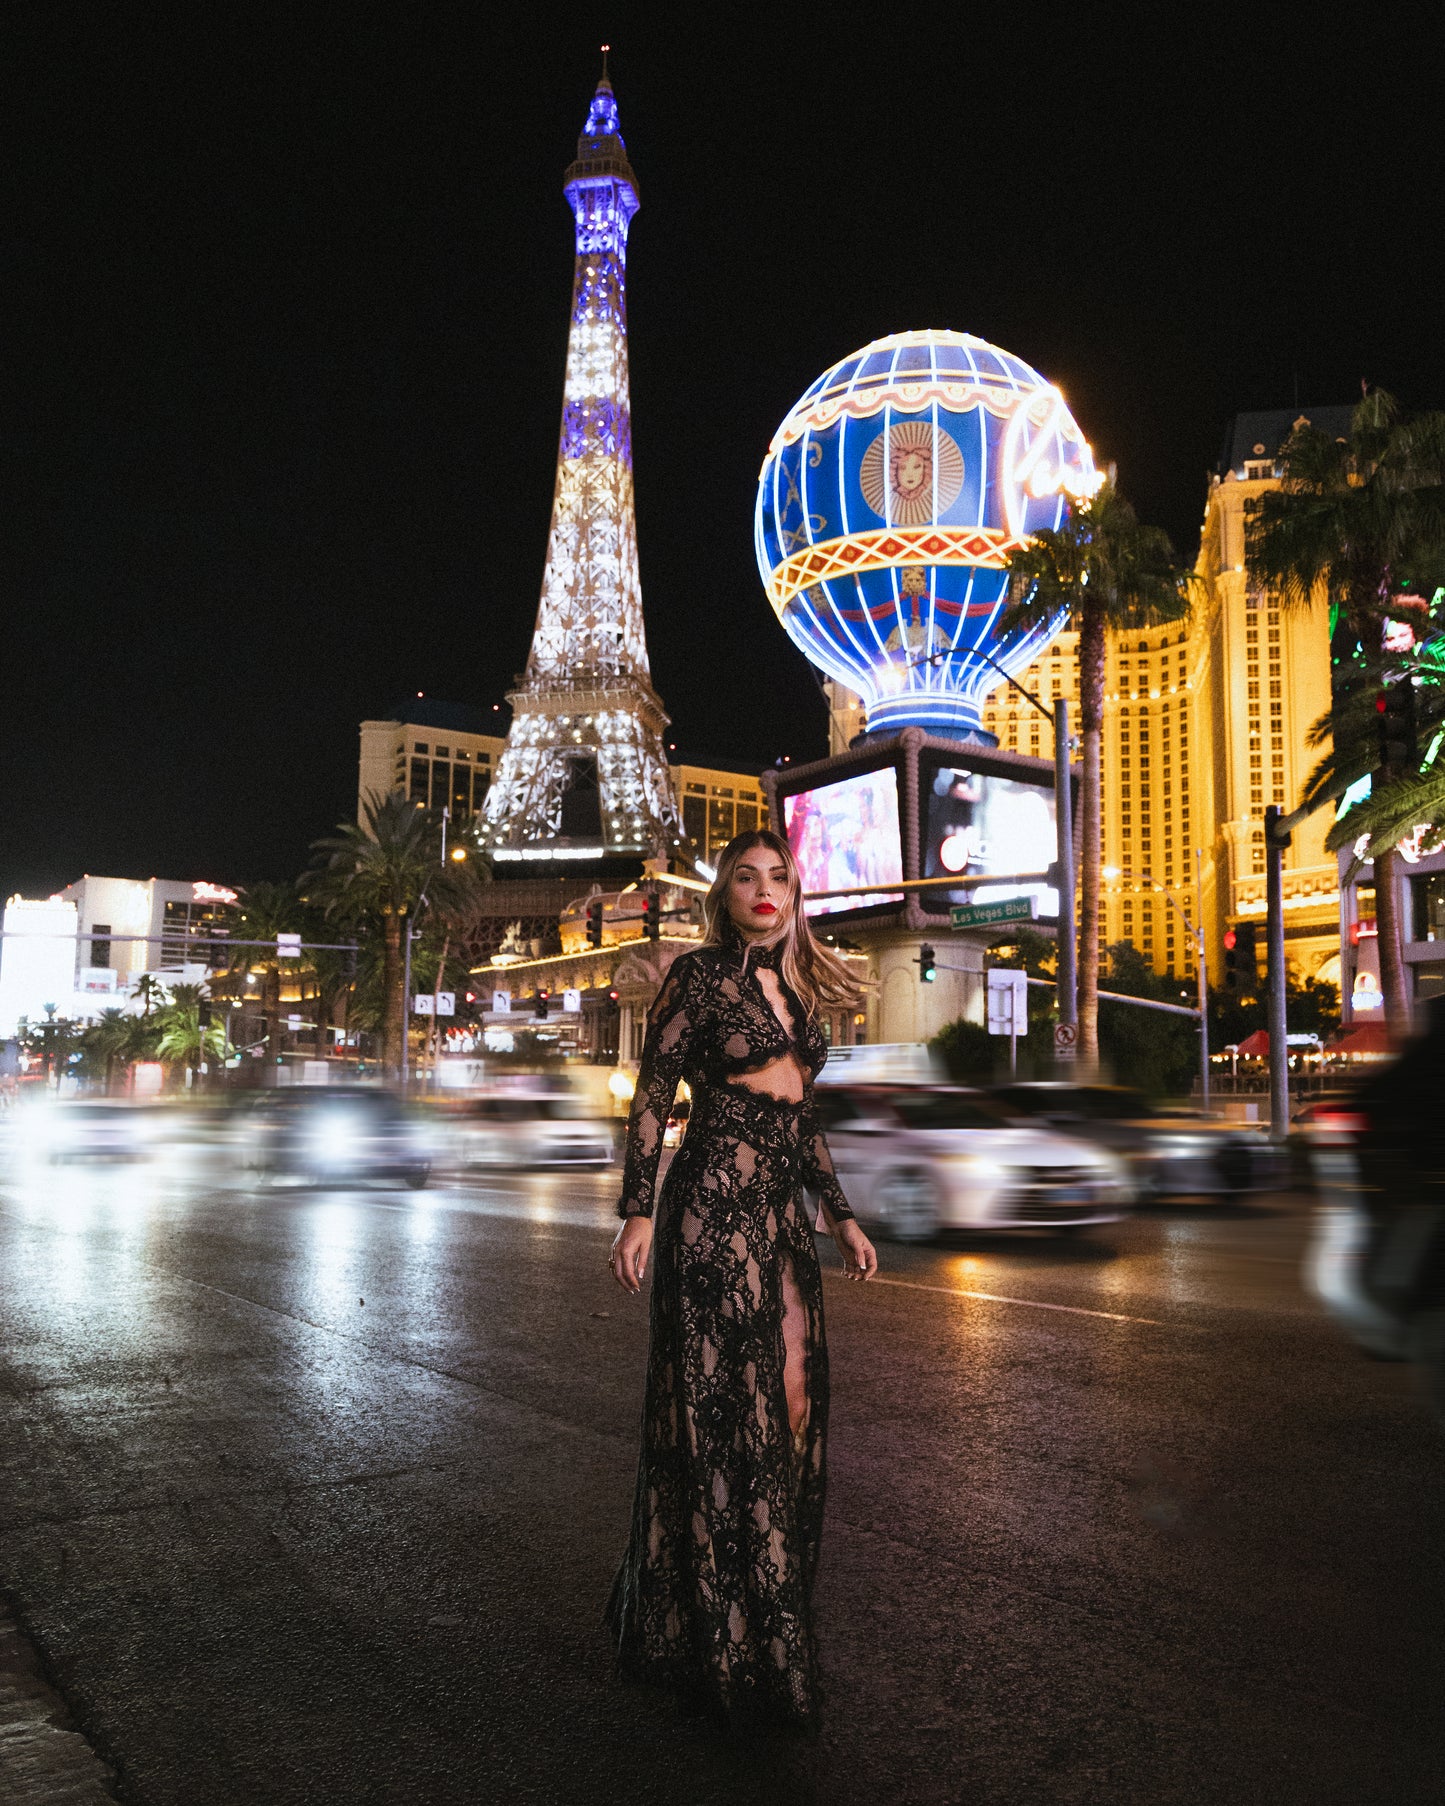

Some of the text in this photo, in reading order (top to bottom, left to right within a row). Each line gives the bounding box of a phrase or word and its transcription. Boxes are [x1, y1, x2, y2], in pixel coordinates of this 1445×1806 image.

[953, 904, 1028, 923] Las Vegas Blvd
